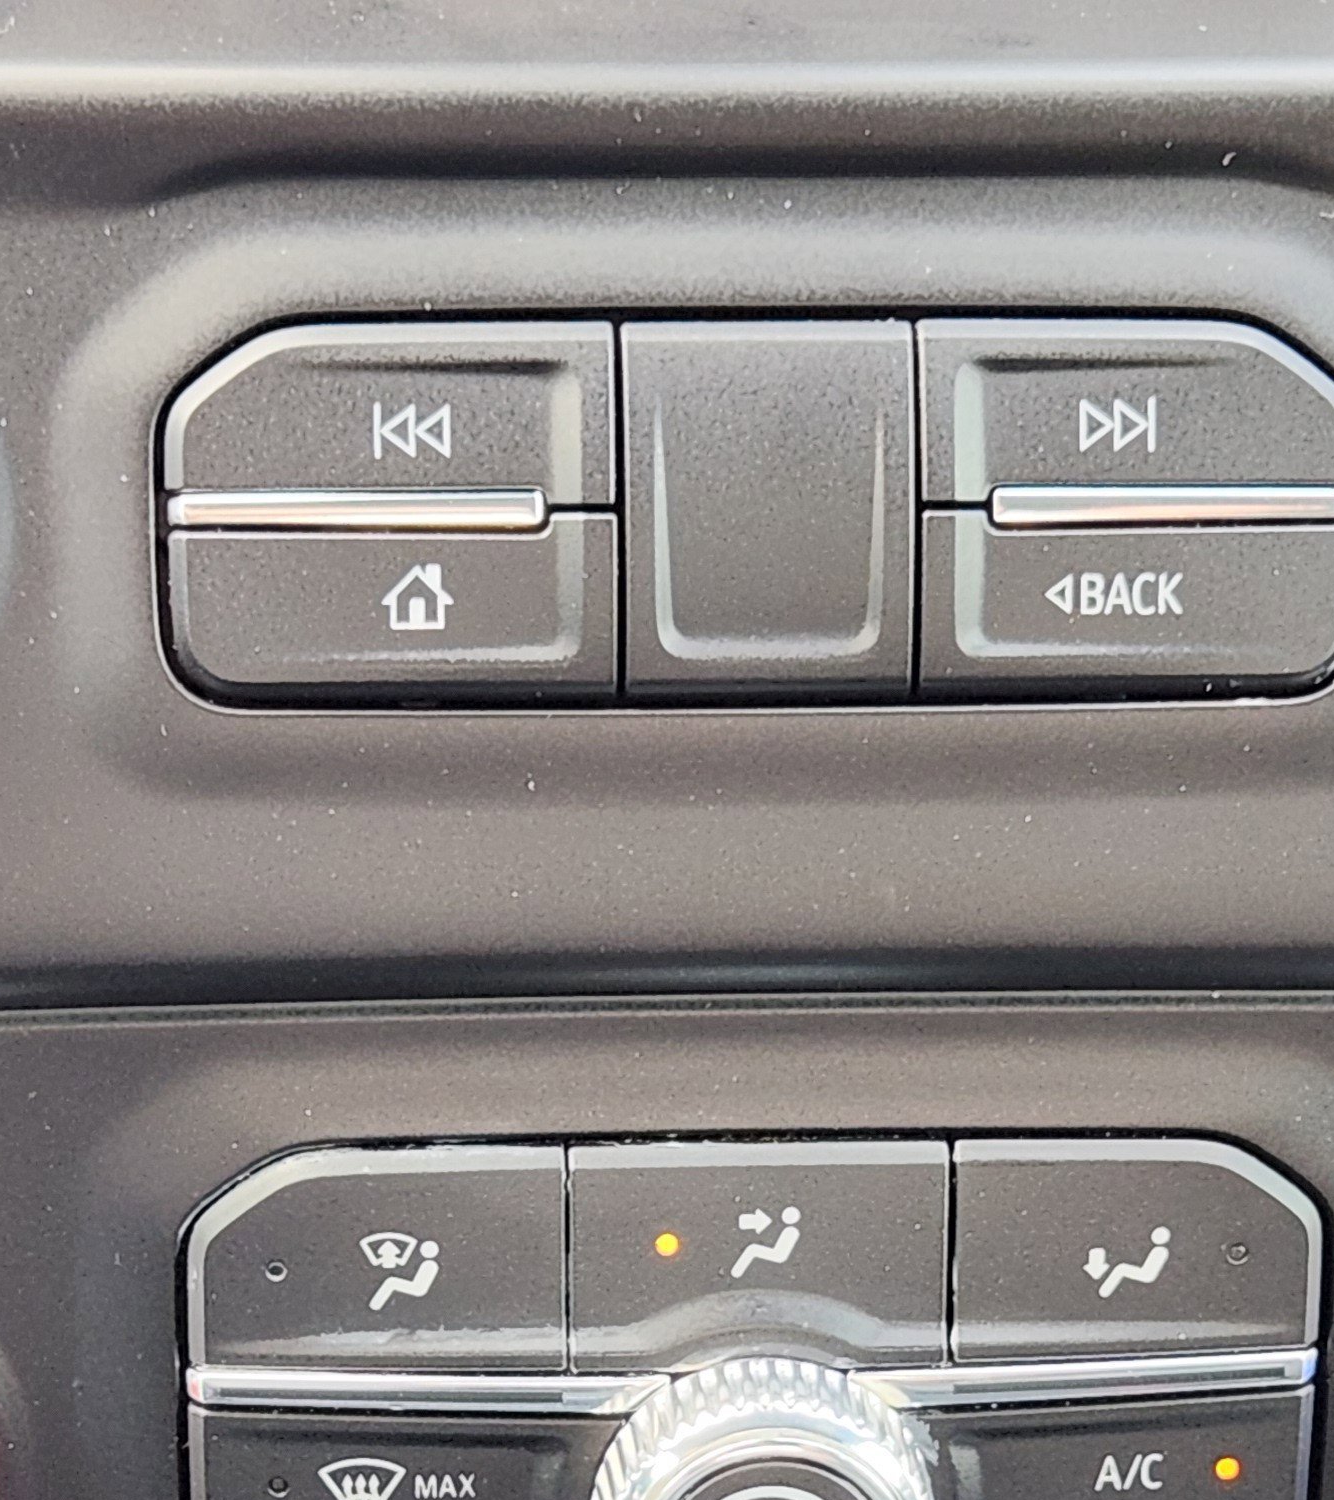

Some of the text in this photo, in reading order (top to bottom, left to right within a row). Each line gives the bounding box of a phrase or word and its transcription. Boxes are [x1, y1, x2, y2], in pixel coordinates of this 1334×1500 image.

[1080, 573, 1183, 615] BACK
[414, 1474, 475, 1499] MAX
[1094, 1453, 1164, 1491] A/C
